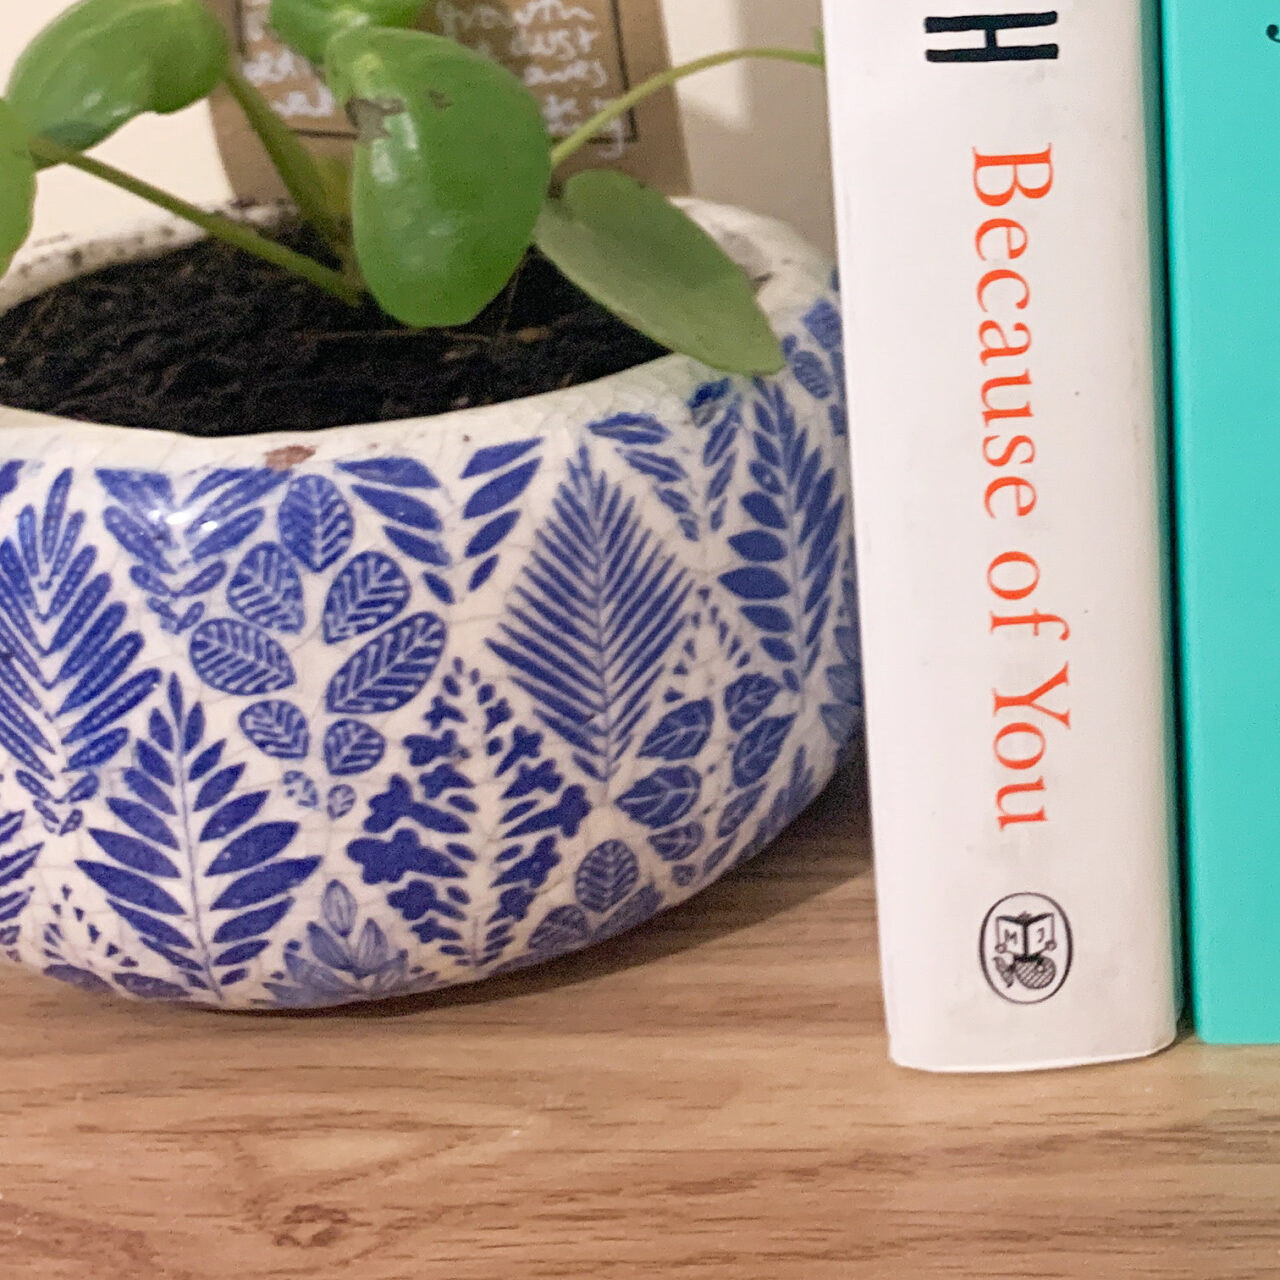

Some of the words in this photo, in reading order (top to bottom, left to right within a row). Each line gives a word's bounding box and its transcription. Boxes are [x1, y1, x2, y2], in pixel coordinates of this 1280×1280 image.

[972, 144, 1054, 518] Because
[986, 550, 1071, 642] of
[992, 660, 1072, 832] You
